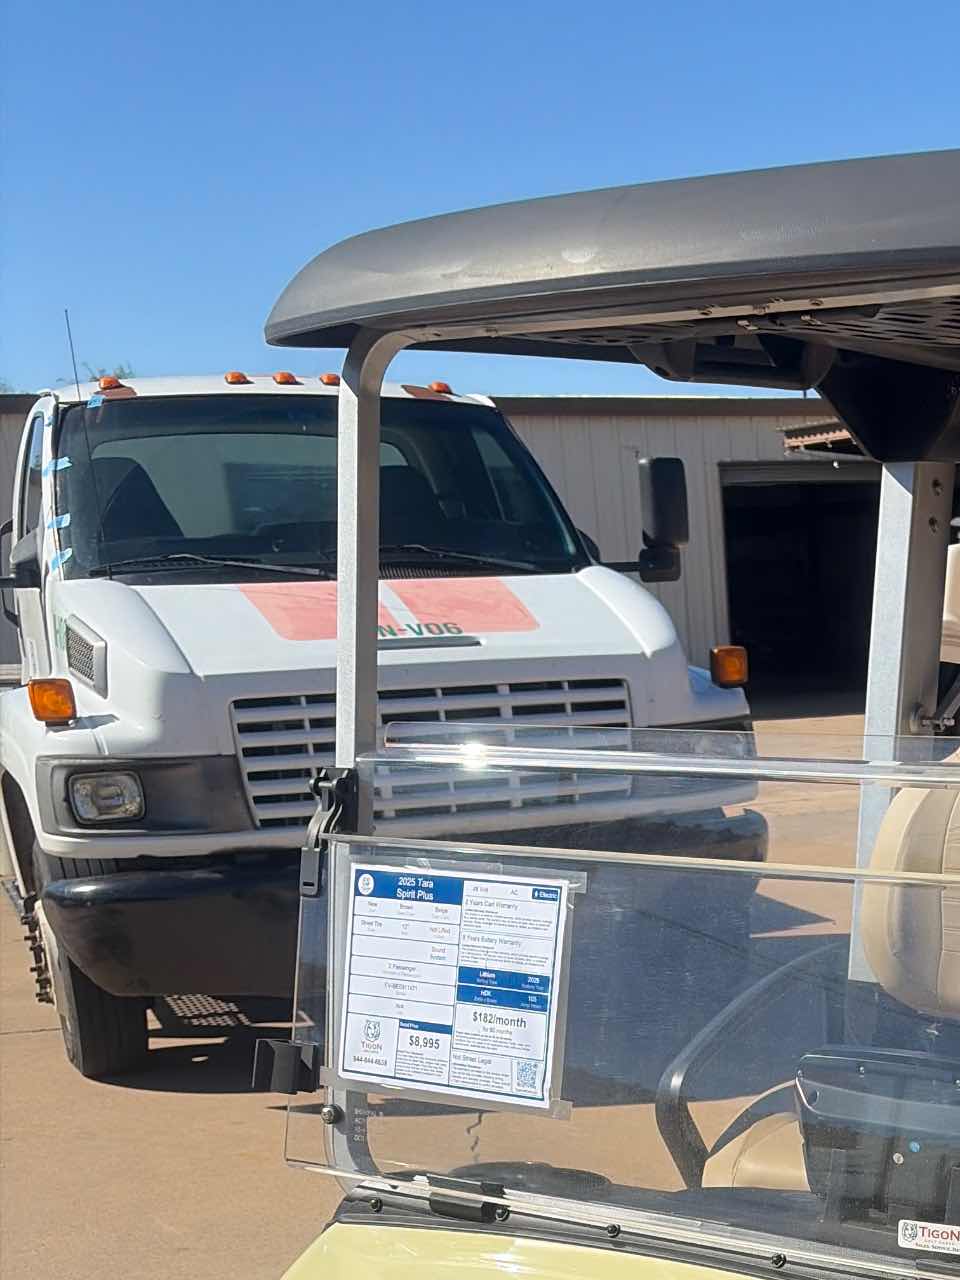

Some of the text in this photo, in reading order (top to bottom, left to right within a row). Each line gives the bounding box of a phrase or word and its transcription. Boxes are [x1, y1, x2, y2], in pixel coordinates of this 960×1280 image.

[397, 876, 434, 889] 2025 Tara
[396, 888, 434, 900] Spirit Plus
[539, 890, 558, 899] Electric
[472, 1011, 527, 1028] $182/month
[409, 1035, 440, 1050] $8,995
[919, 1226, 960, 1242] TIGON
